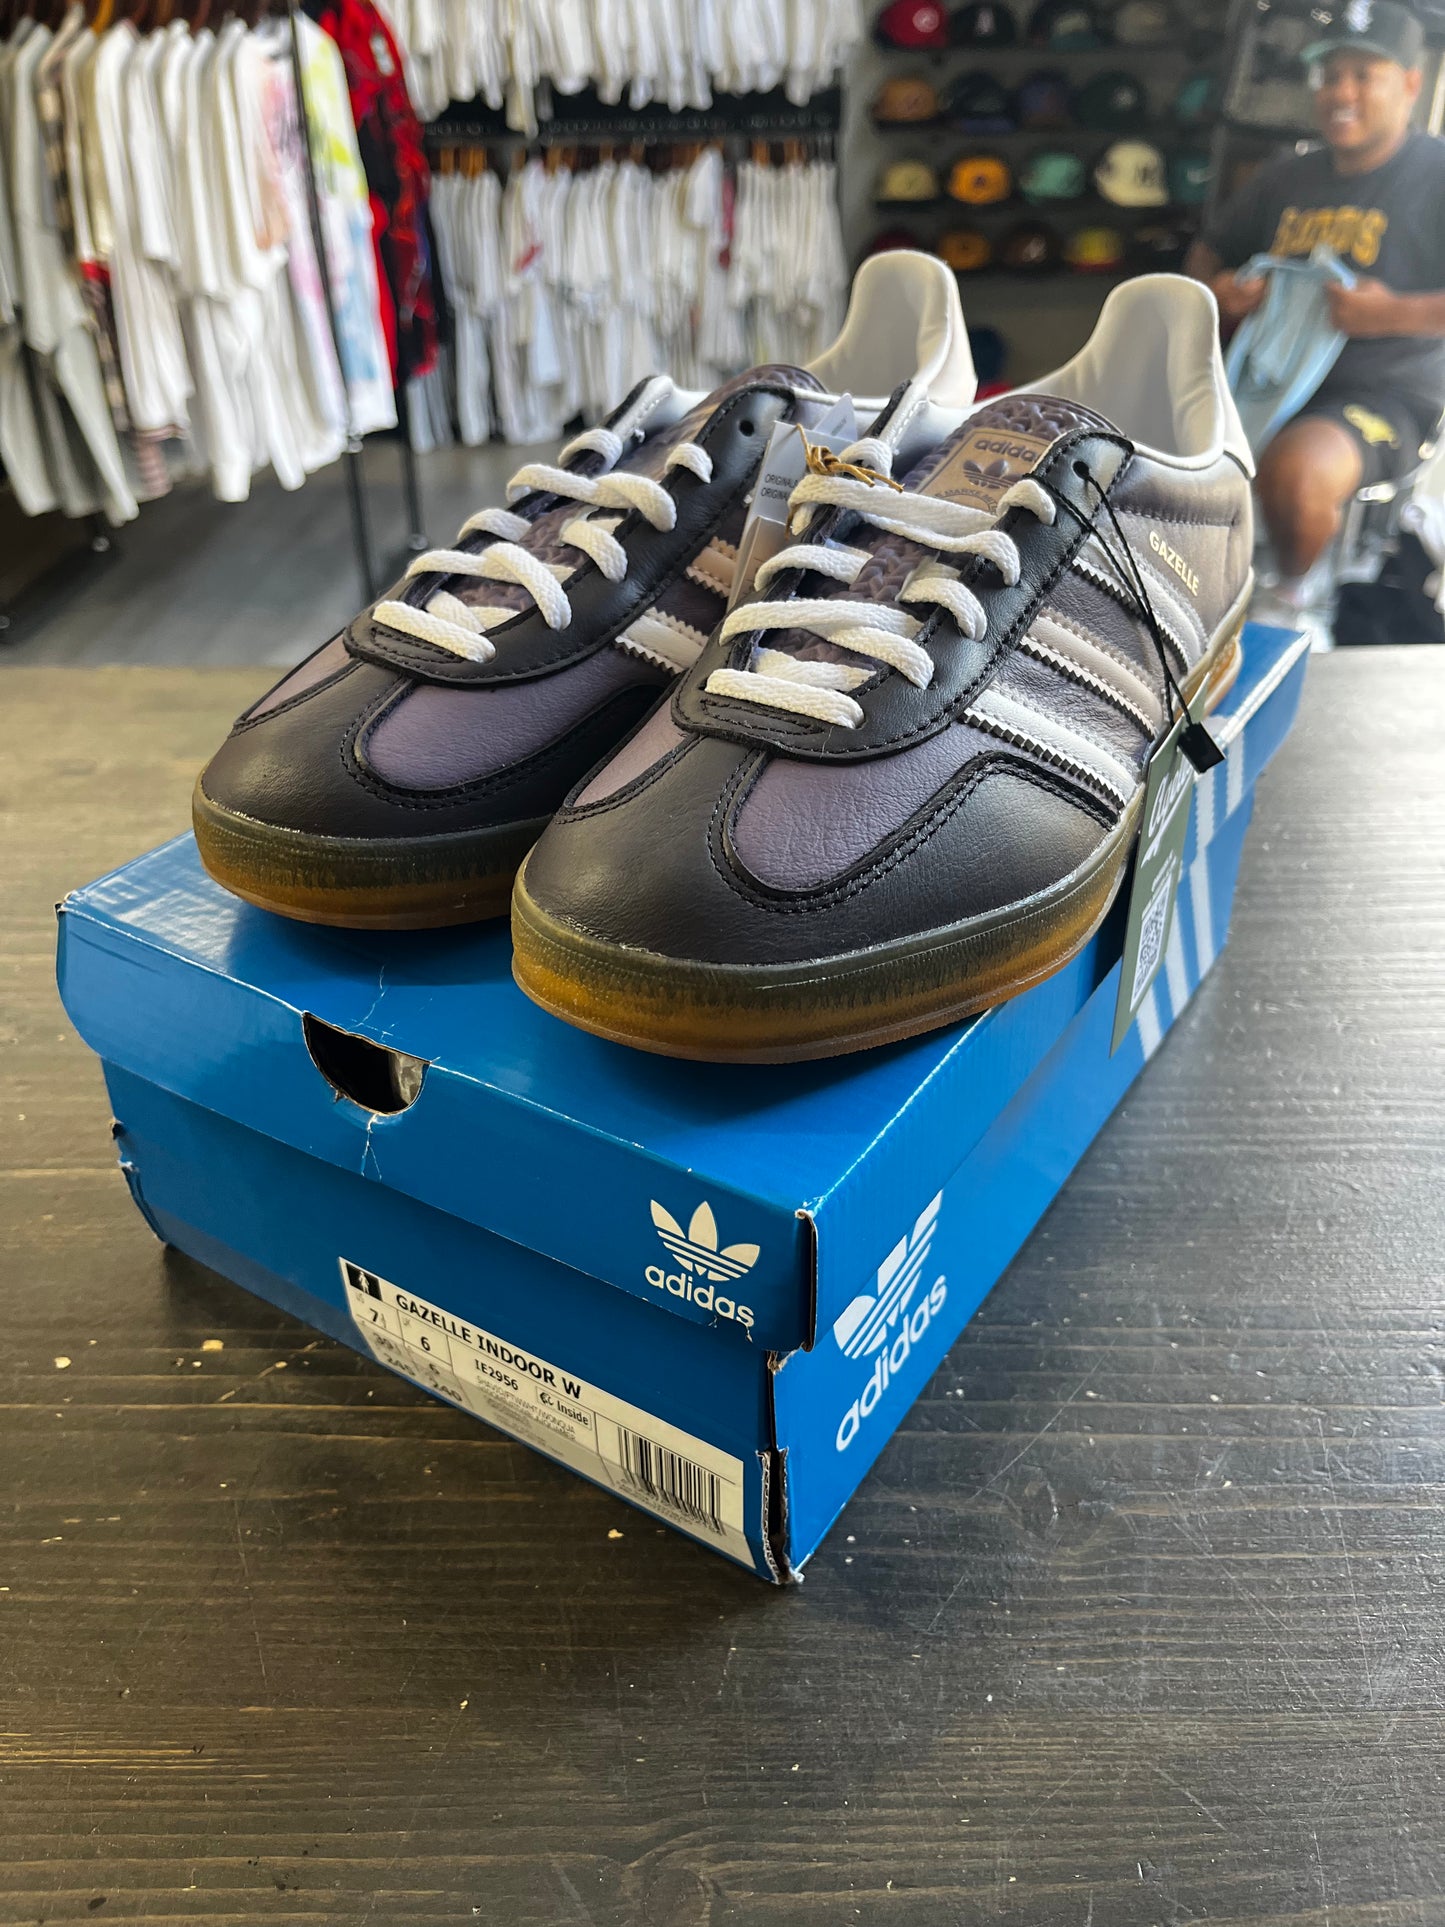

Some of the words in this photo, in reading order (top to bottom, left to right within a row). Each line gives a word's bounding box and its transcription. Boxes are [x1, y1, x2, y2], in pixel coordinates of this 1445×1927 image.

[974, 439, 1041, 463] adida
[1149, 530, 1199, 597] GAZELLE
[645, 1264, 755, 1328] adidas
[396, 1294, 472, 1344] GAZELLE
[477, 1334, 557, 1388] INDOOR
[562, 1376, 581, 1399] W
[421, 1336, 431, 1351] 6
[836, 1274, 948, 1452] adidas
[474, 1359, 519, 1390] IE2956
[556, 1400, 589, 1426] Inside
